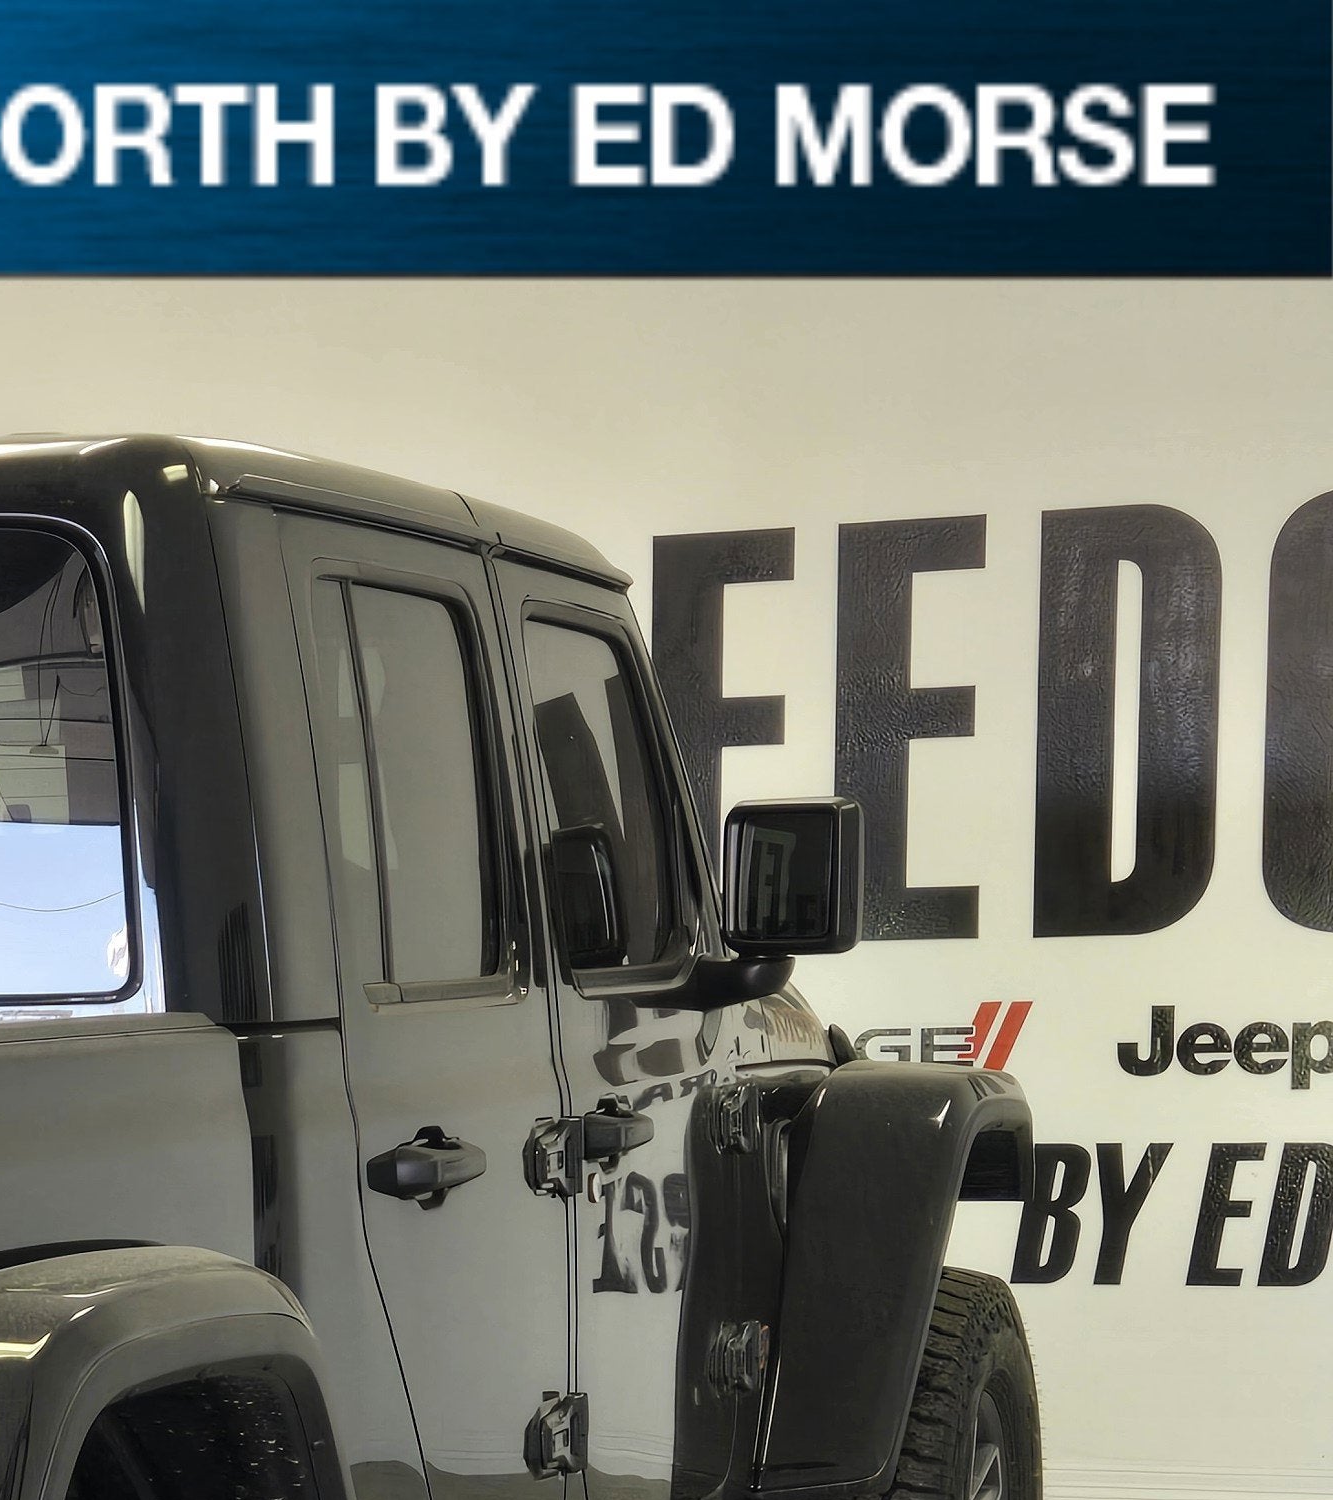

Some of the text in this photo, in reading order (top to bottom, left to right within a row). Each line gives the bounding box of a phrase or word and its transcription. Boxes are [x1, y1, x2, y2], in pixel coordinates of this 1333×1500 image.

[1117, 1004, 1333, 1091] Jeep
[1010, 1142, 1333, 1287] BY ED
